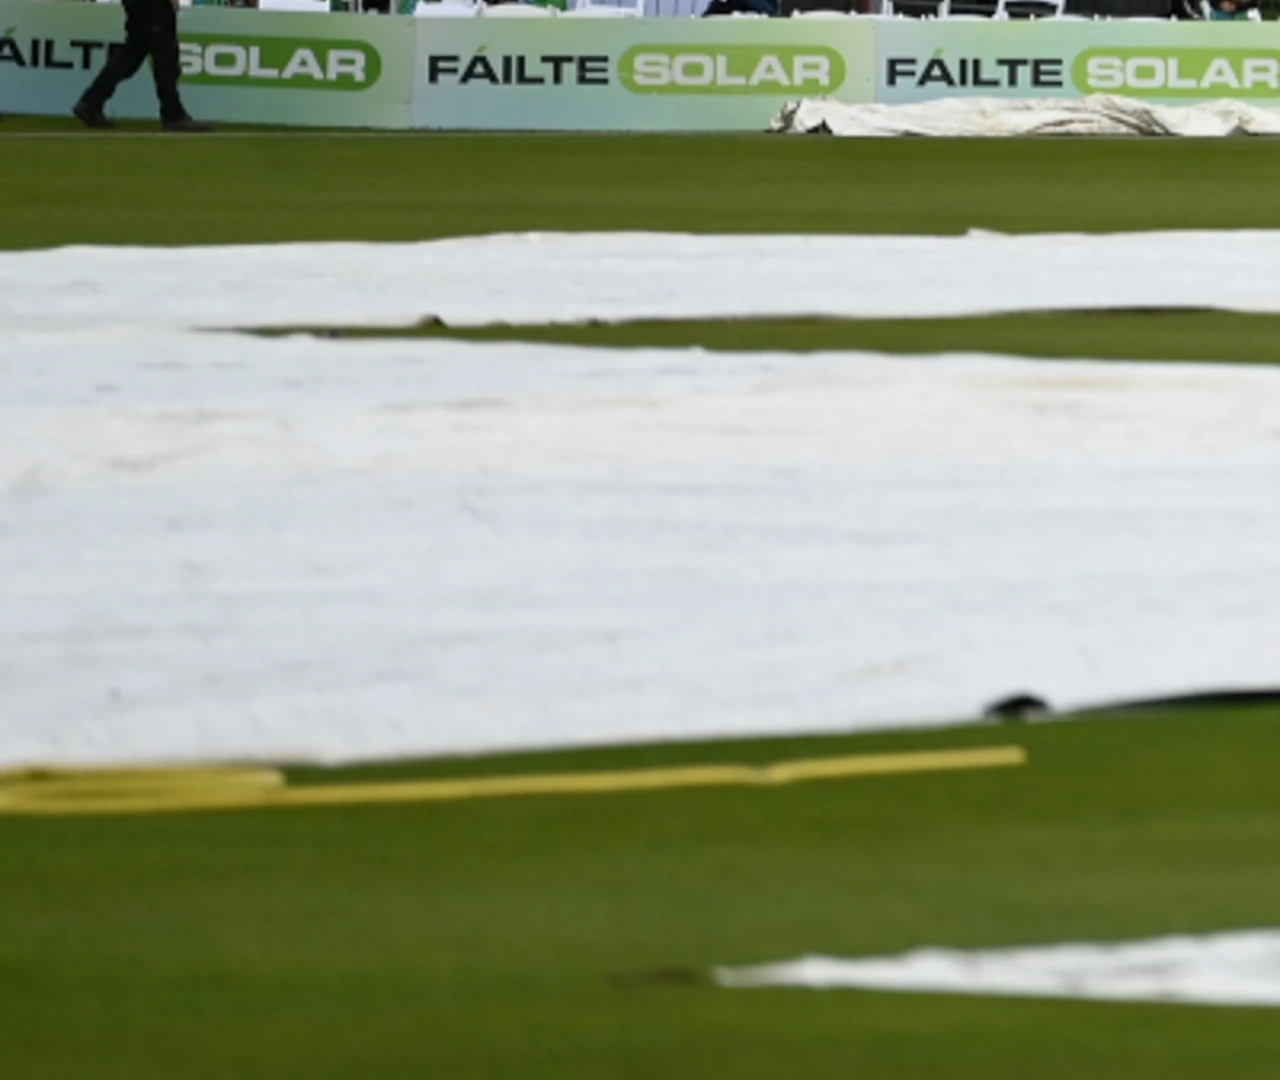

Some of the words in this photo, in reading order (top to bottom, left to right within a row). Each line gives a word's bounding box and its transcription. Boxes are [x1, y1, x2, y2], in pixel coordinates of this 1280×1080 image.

[0, 27, 128, 70] ÁILT
[178, 42, 366, 82] SOLAR
[428, 45, 609, 86] FÁILTE
[633, 53, 830, 87] SOLAR
[886, 48, 1063, 88] FÁILTE
[1087, 56, 1280, 90] SOLAR
